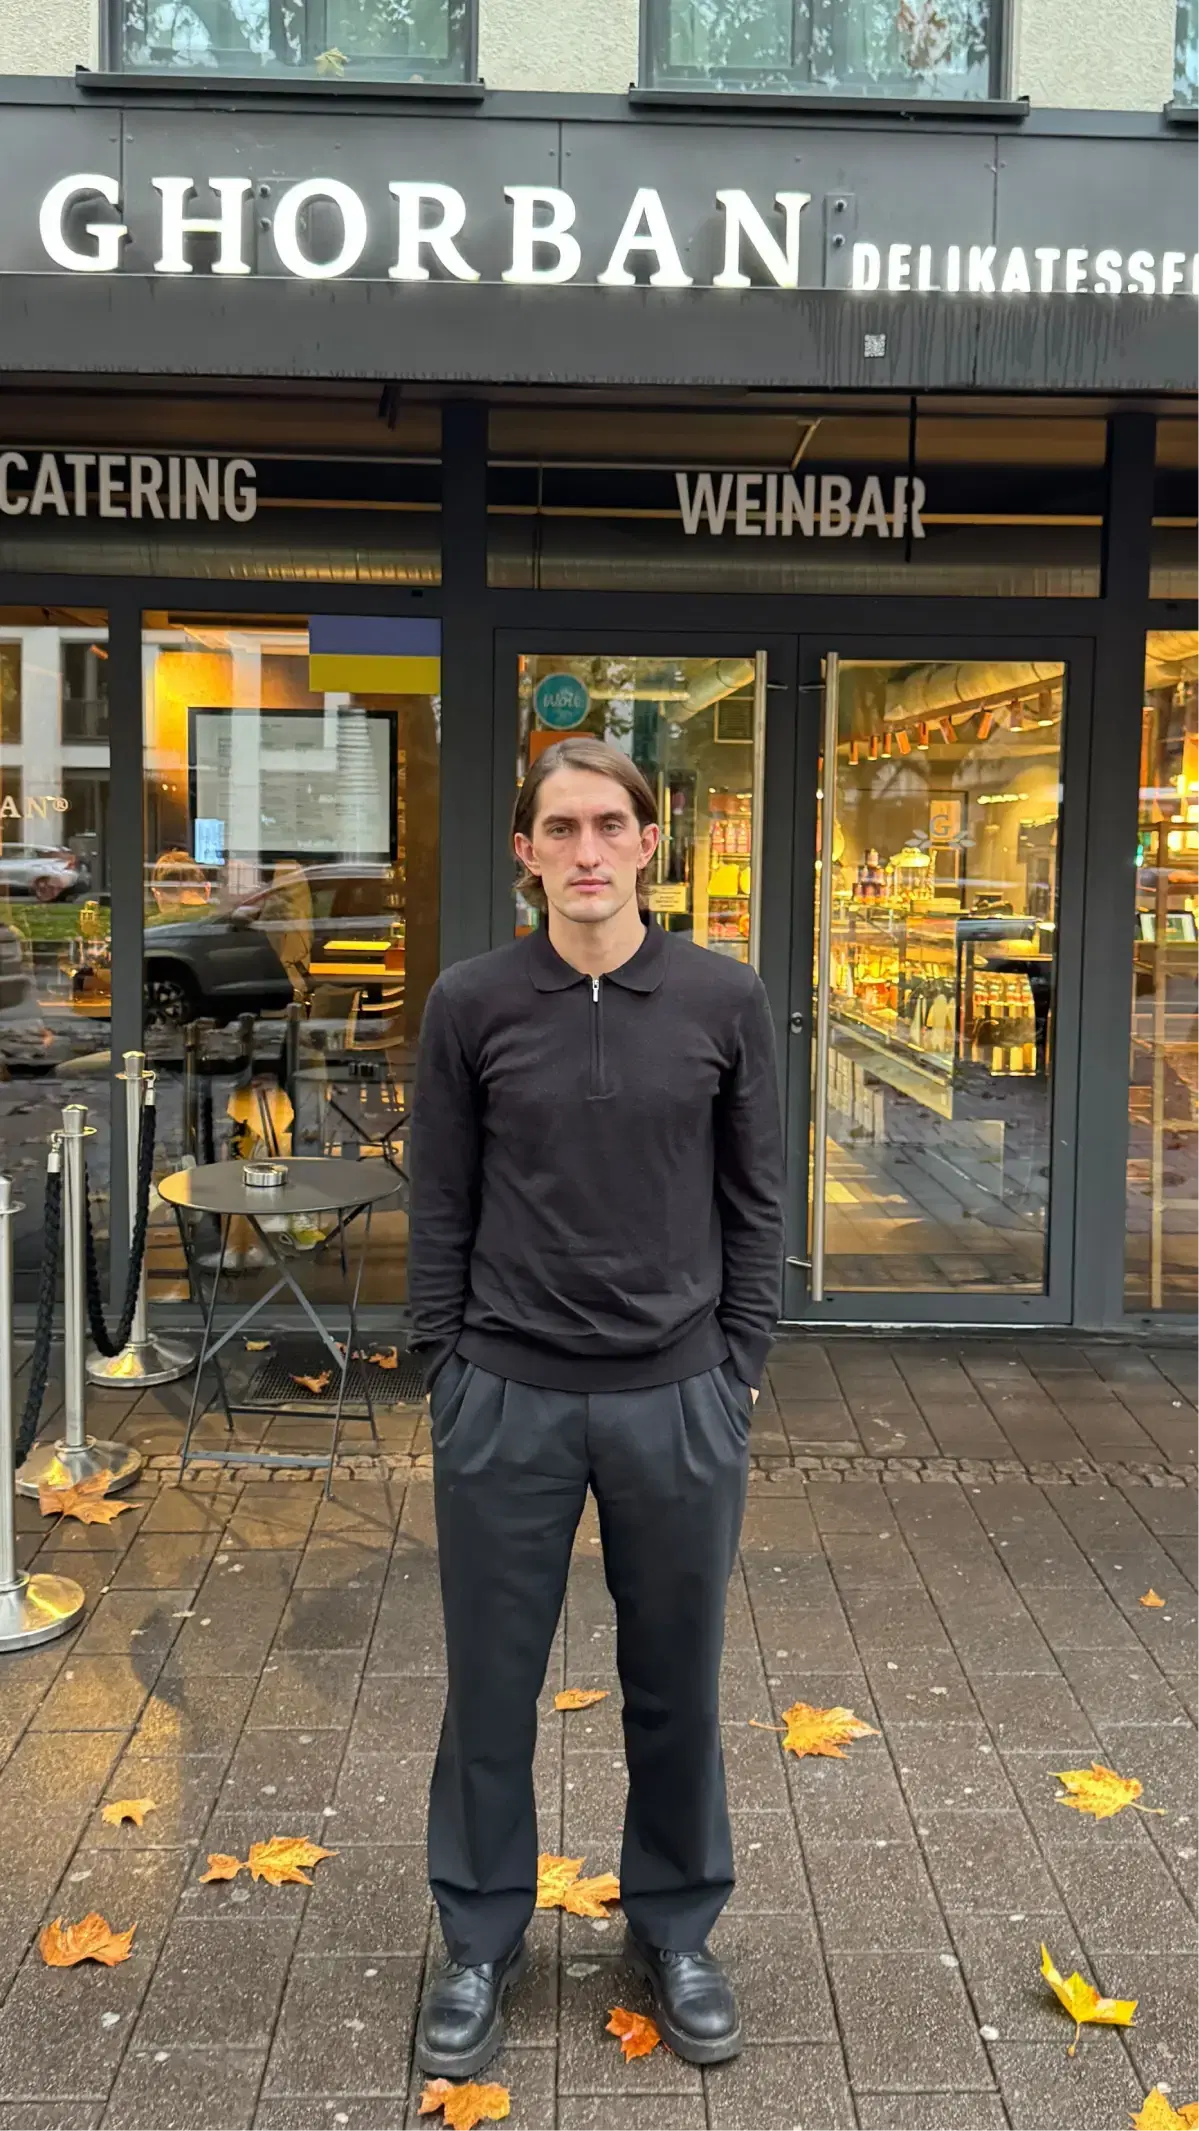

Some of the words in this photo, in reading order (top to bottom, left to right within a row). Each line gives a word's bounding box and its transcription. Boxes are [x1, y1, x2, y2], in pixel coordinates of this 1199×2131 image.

[39, 173, 811, 290] GHORBAN
[851, 242, 1199, 295] DELIKATESSE
[0, 451, 257, 523] CATERING
[675, 472, 926, 538] WEINBAR
